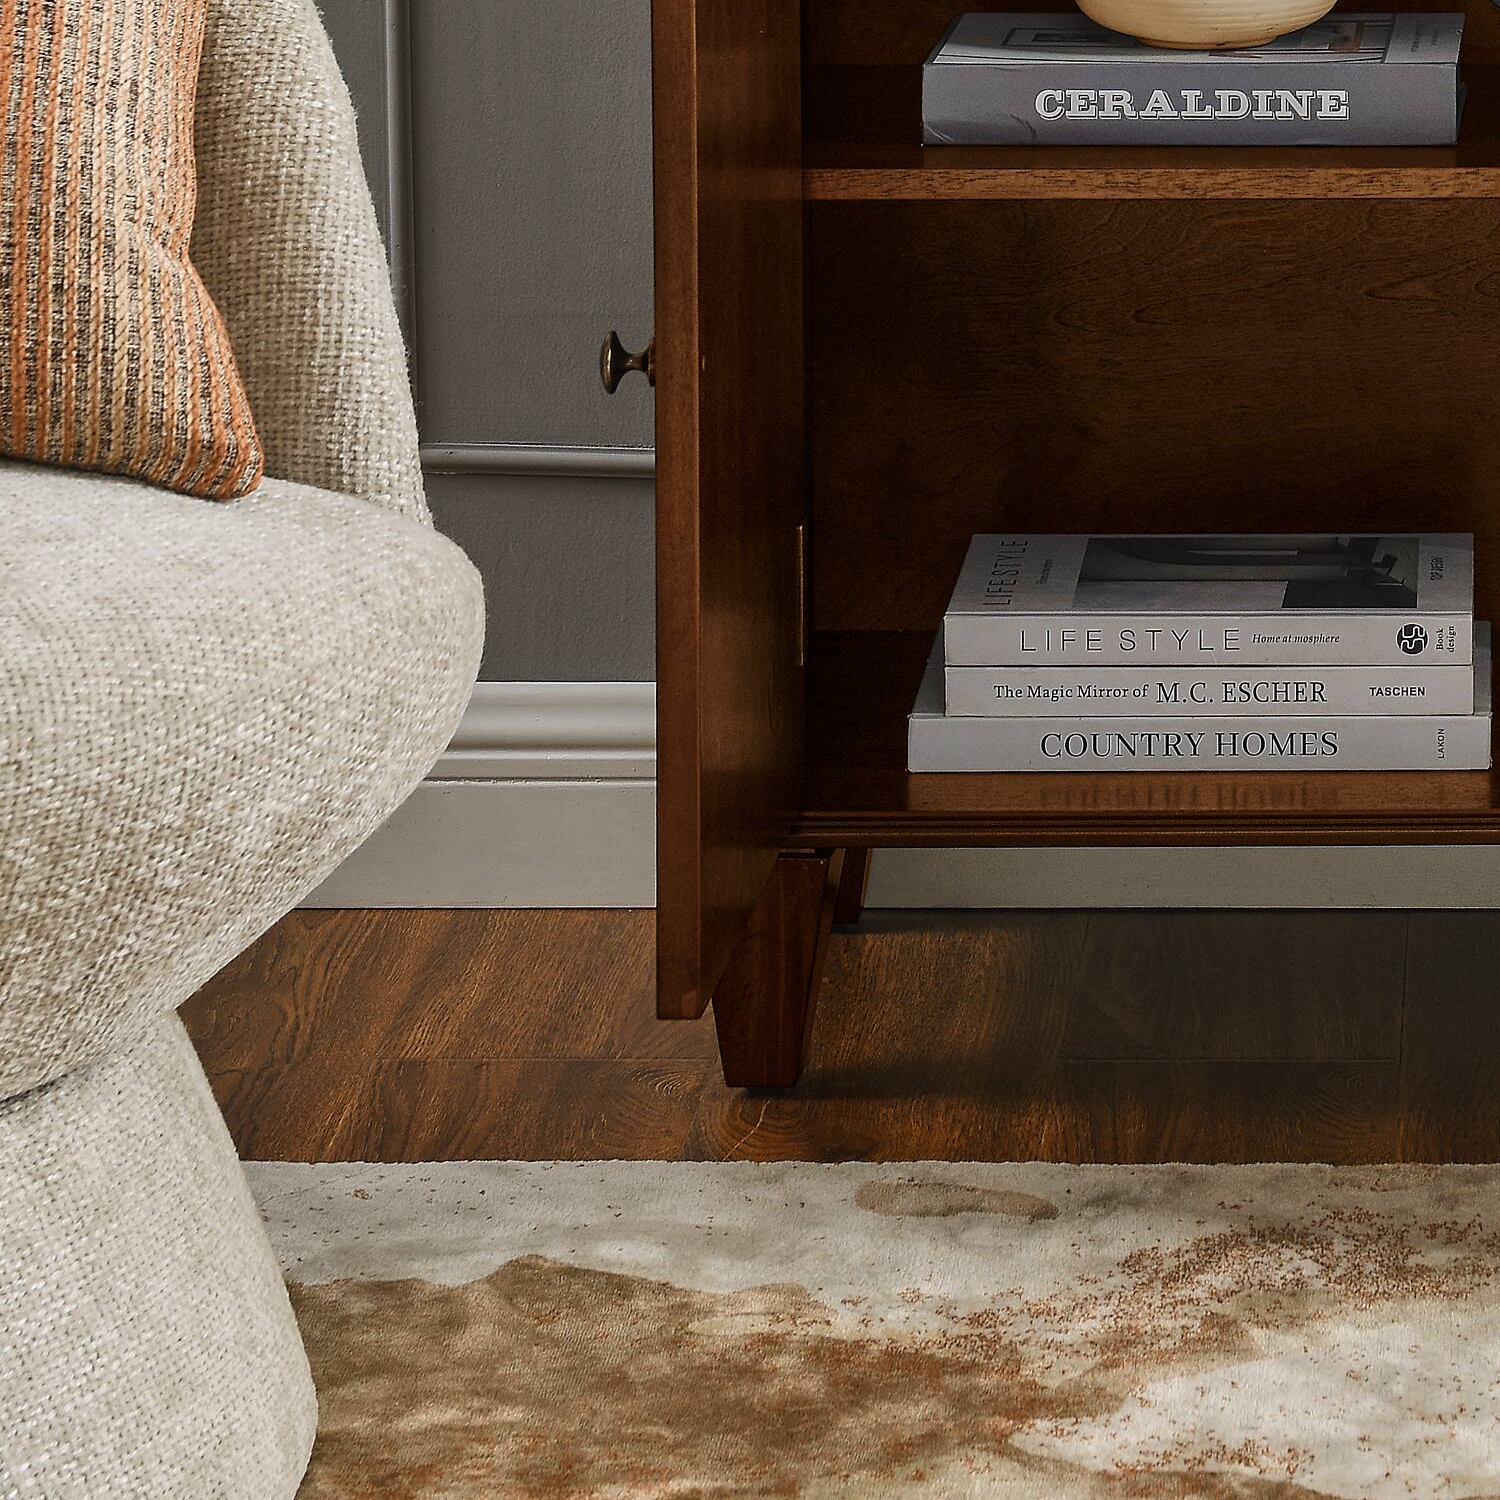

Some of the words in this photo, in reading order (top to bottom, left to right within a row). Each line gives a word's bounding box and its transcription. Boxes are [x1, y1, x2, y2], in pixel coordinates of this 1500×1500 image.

[1034, 89, 1350, 121] CERALDINE
[1252, 633, 1281, 644] Home
[1435, 628, 1444, 650] Book
[1446, 626, 1457, 653] design
[993, 685, 1023, 699] The
[1026, 685, 1073, 702] Magic
[1076, 684, 1129, 698] Mirror
[1132, 684, 1149, 698] of
[1155, 682, 1214, 703] M.C.
[1221, 681, 1328, 703] ESCHER
[1369, 686, 1425, 697] TASCHEN
[1041, 732, 1206, 758] COUNTRY
[1214, 732, 1338, 757] HOMES
[1437, 728, 1445, 759] LAKON
